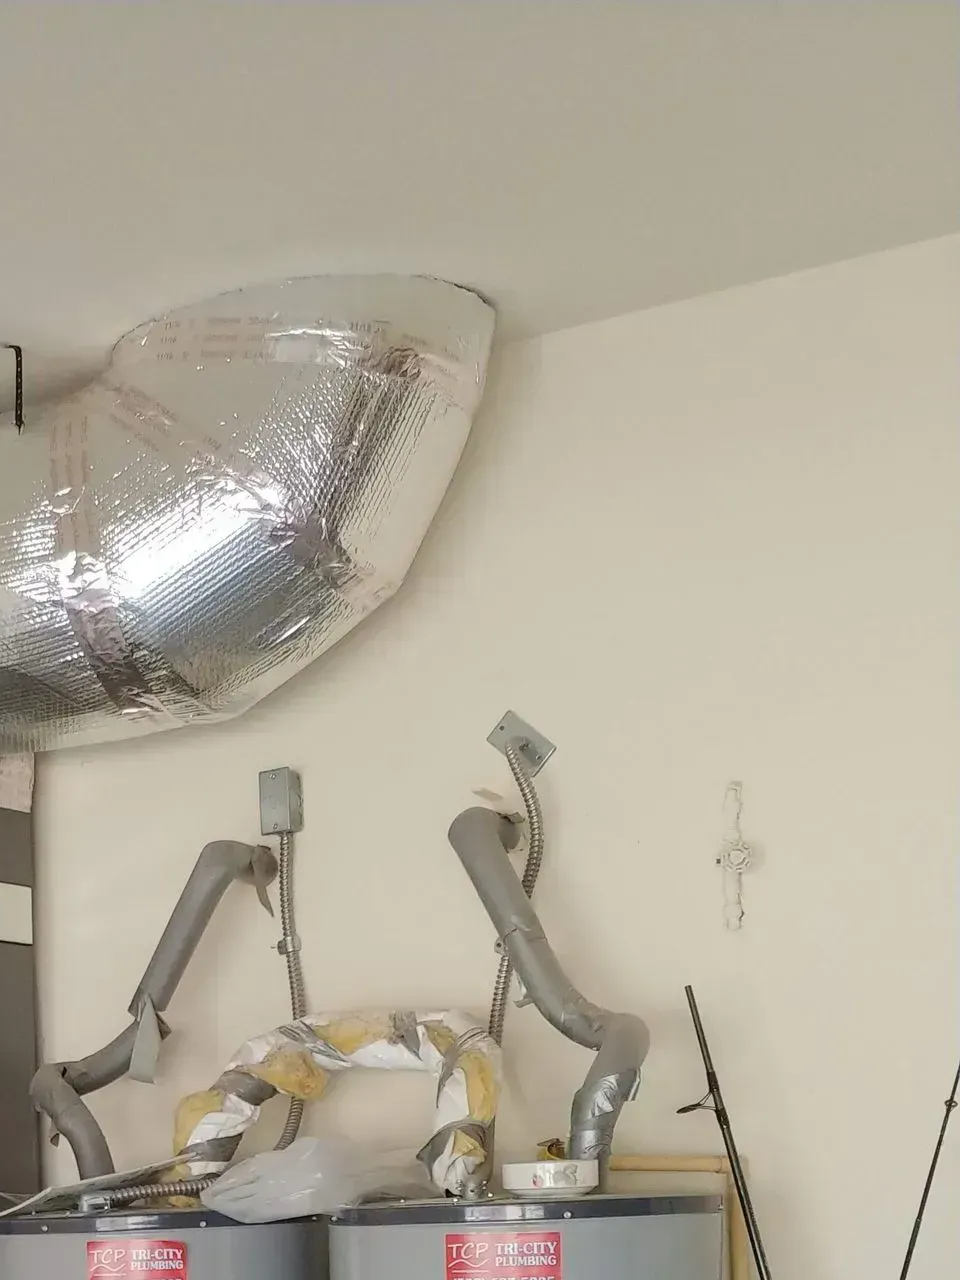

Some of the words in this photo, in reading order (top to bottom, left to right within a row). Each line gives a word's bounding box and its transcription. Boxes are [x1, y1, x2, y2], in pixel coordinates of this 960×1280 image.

[89, 1248, 126, 1264] TCP
[131, 1248, 183, 1260] TRI-CITY
[447, 1242, 489, 1259] TCP
[494, 1241, 558, 1255] TRI-CITY
[130, 1260, 184, 1271] PLUMBING
[495, 1255, 557, 1267] PLUMBING
